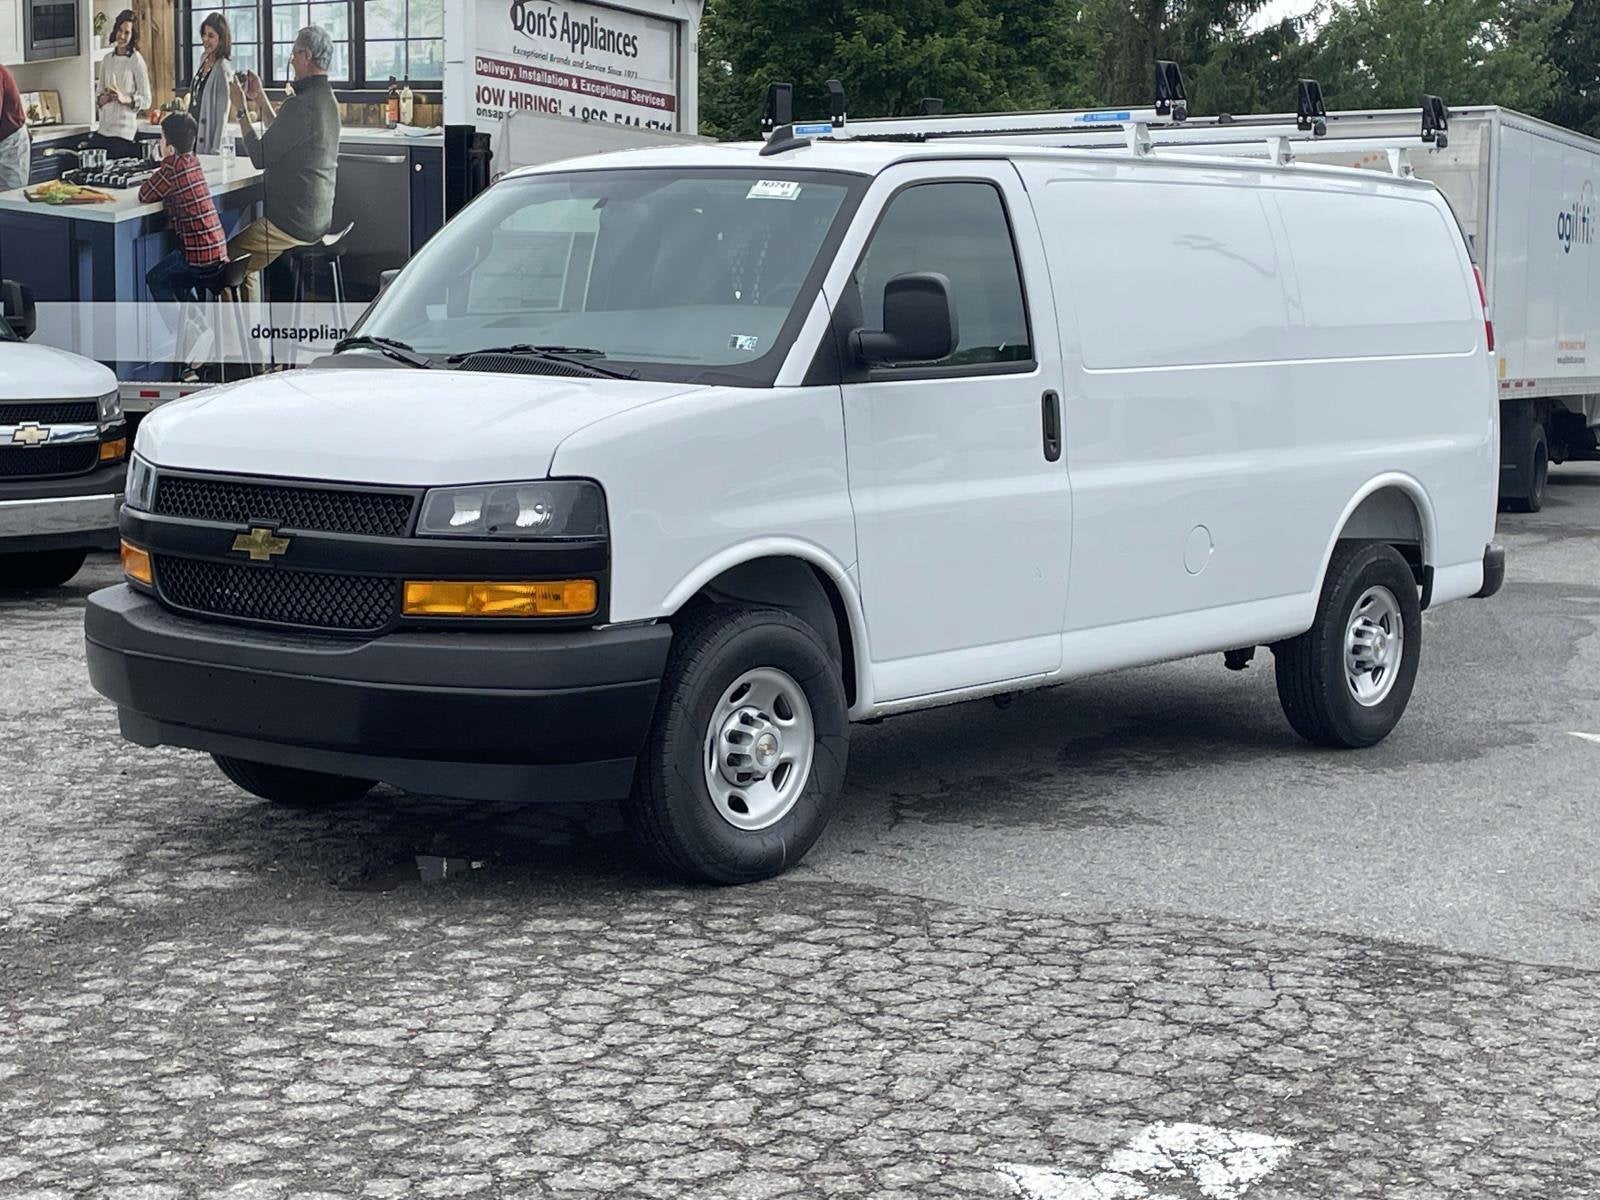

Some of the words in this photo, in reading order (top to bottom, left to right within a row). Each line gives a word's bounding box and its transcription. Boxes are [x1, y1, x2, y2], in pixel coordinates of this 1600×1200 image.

[510, 0, 557, 39] Don's
[560, 11, 638, 58] Appliances
[513, 45, 548, 60] Exceptional
[550, 54, 570, 65] Brands
[572, 60, 584, 68] and
[585, 61, 606, 73] Service
[608, 65, 622, 76] Since
[476, 59, 517, 79] Delivery,
[519, 67, 569, 87] Installation
[572, 78, 578, 89] &
[581, 79, 629, 99] Exceptional
[631, 90, 666, 107] Services
[509, 90, 562, 115] HIRING!
